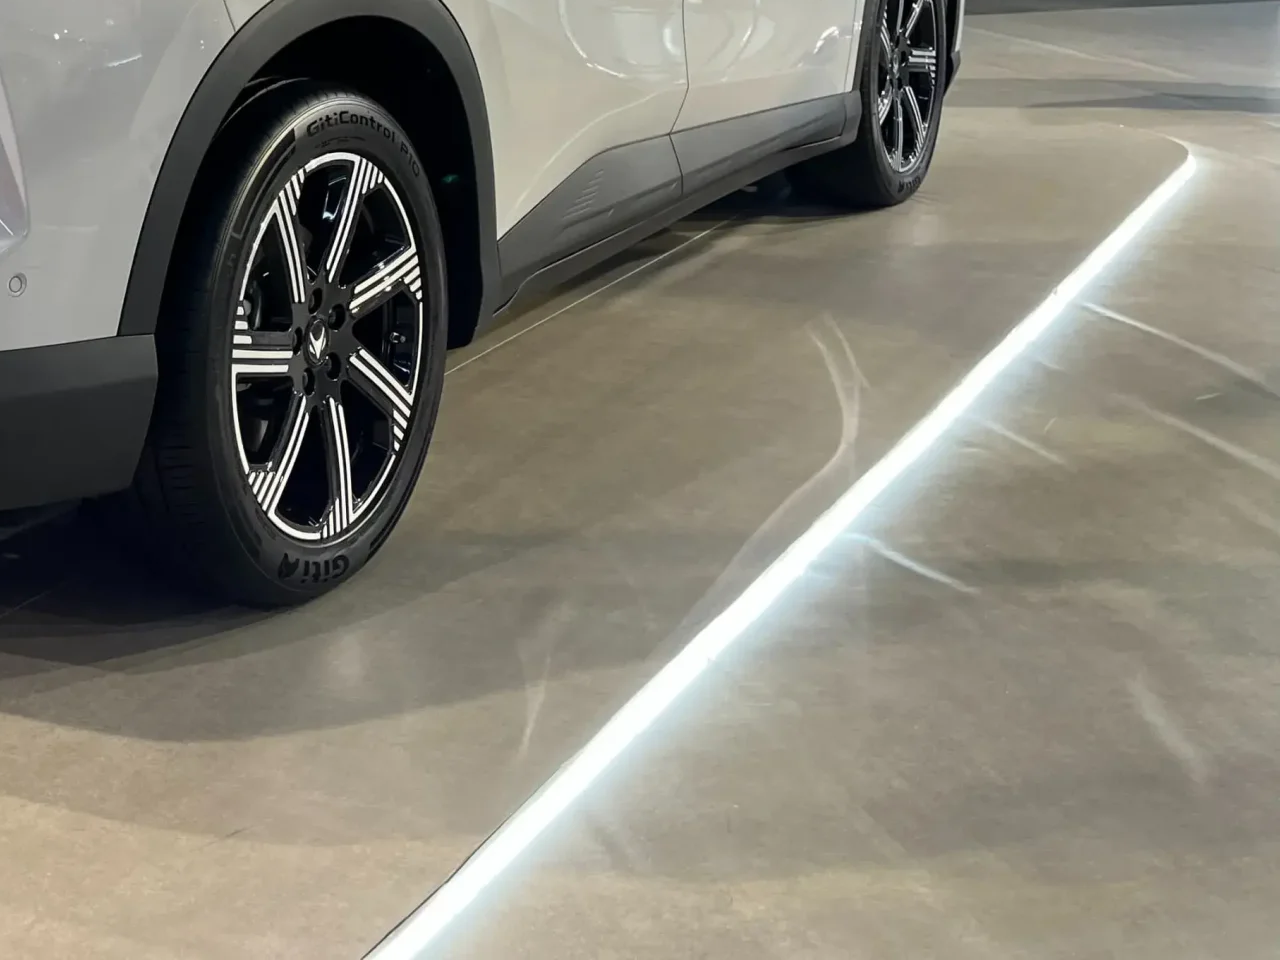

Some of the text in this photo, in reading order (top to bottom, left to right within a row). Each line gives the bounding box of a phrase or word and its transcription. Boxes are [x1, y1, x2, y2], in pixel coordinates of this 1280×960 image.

[306, 111, 395, 142] GitiControl
[400, 141, 420, 177] P10
[300, 555, 350, 583] Giti
